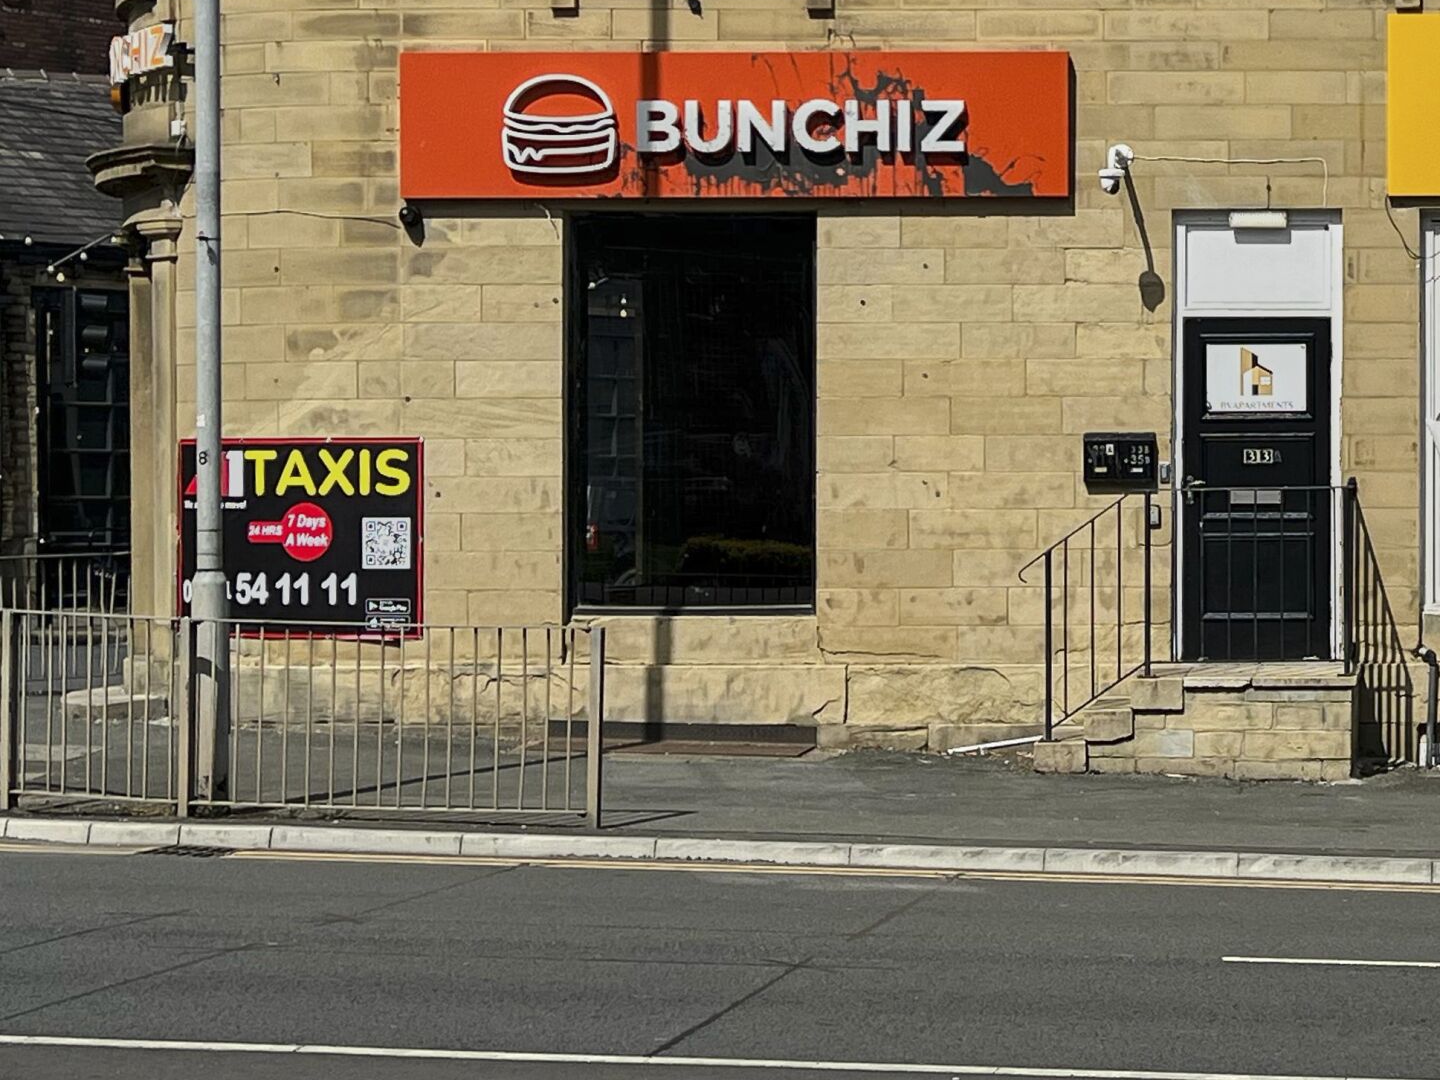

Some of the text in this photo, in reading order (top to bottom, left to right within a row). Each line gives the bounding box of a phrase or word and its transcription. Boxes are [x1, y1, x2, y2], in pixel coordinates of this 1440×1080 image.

[636, 99, 966, 154] BUNCHIZ
[198, 451, 208, 465] 8
[243, 448, 411, 497] TAXIS
[261, 524, 283, 536] HRS
[287, 514, 327, 530] 7 Days
[285, 532, 328, 547] A Week
[235, 571, 269, 606] 54
[275, 571, 311, 606] 11
[321, 571, 358, 606] 11
